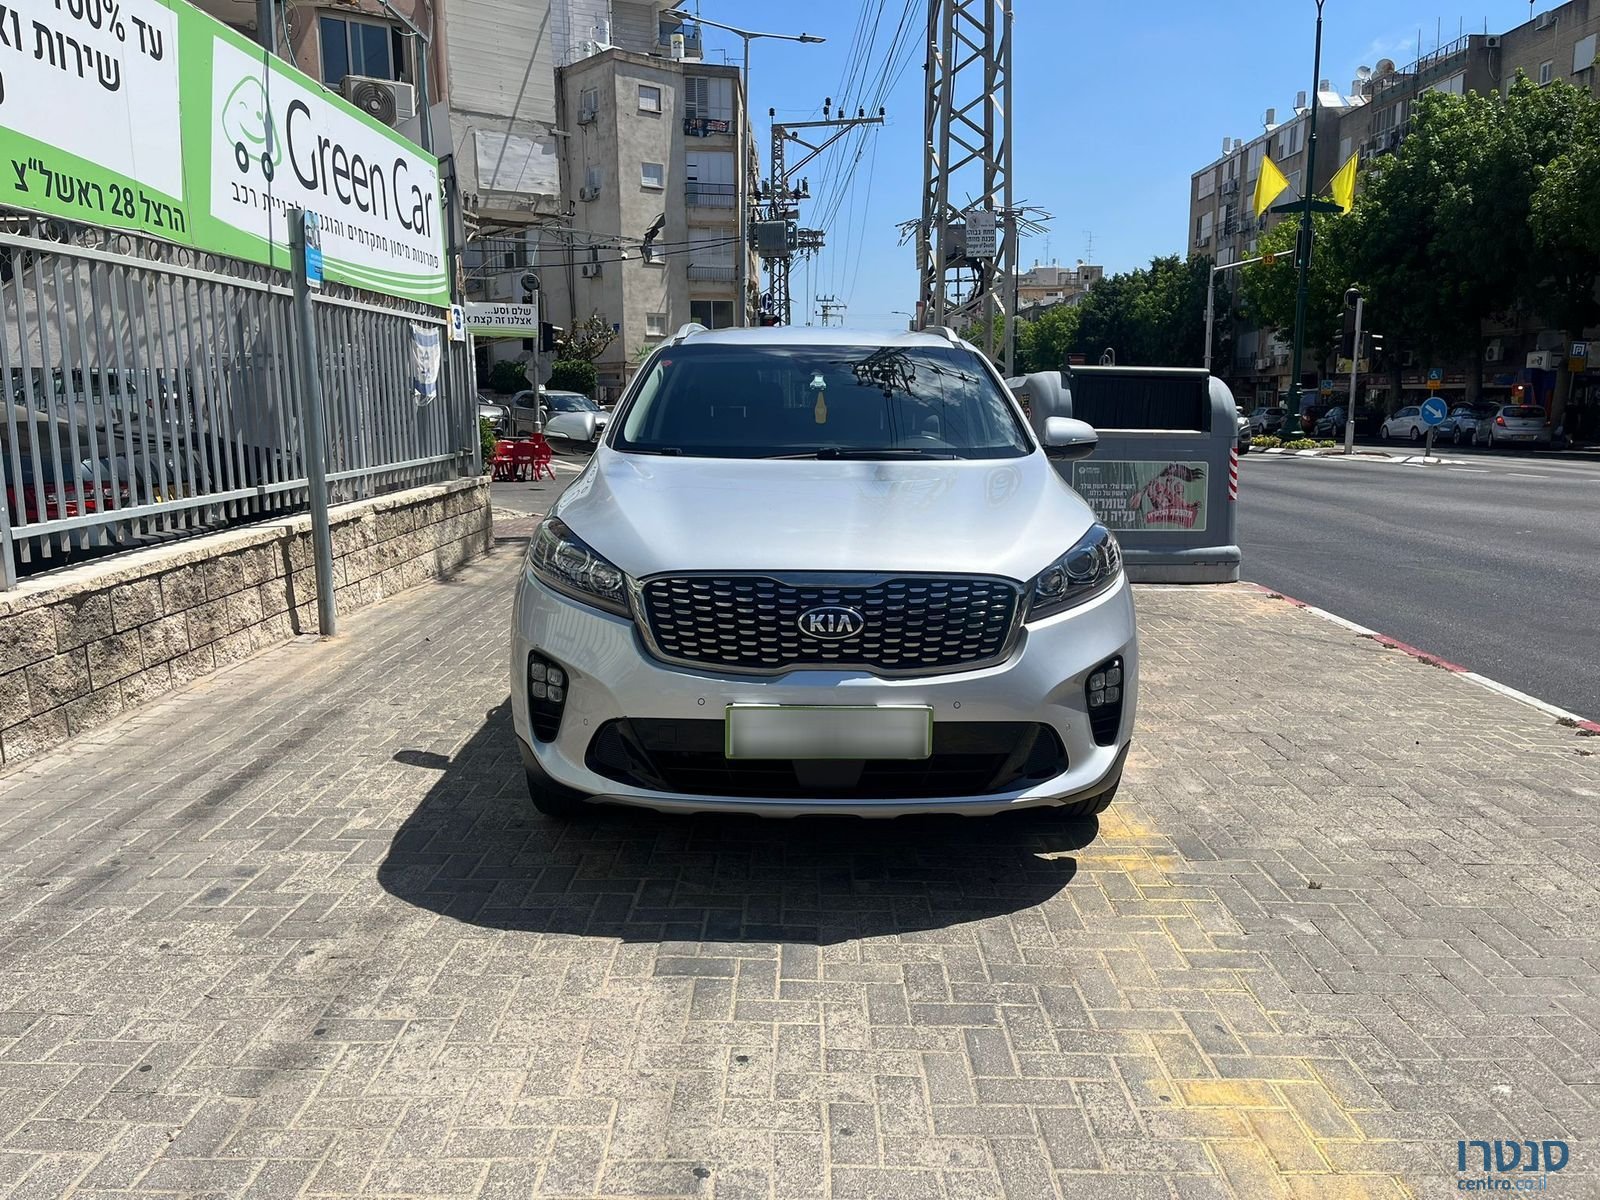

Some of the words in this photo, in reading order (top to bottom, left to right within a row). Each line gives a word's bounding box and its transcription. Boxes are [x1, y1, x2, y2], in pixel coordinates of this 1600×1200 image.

[131, 15, 163, 61] עד
[32, 20, 120, 91] שירות
[286, 99, 388, 221] Green
[393, 158, 433, 238] Car
[109, 183, 135, 219] 28
[232, 182, 257, 207] רכב
[139, 190, 185, 233] הרצל
[347, 224, 388, 251] מתקדמים
[390, 239, 410, 258] מימון
[412, 247, 439, 268] פתרונות
[473, 316, 492, 326] קצת
[495, 316, 505, 324] זה
[508, 316, 532, 325] אצלנו
[512, 306, 532, 315] שלם
[809, 614, 853, 632] KIA
